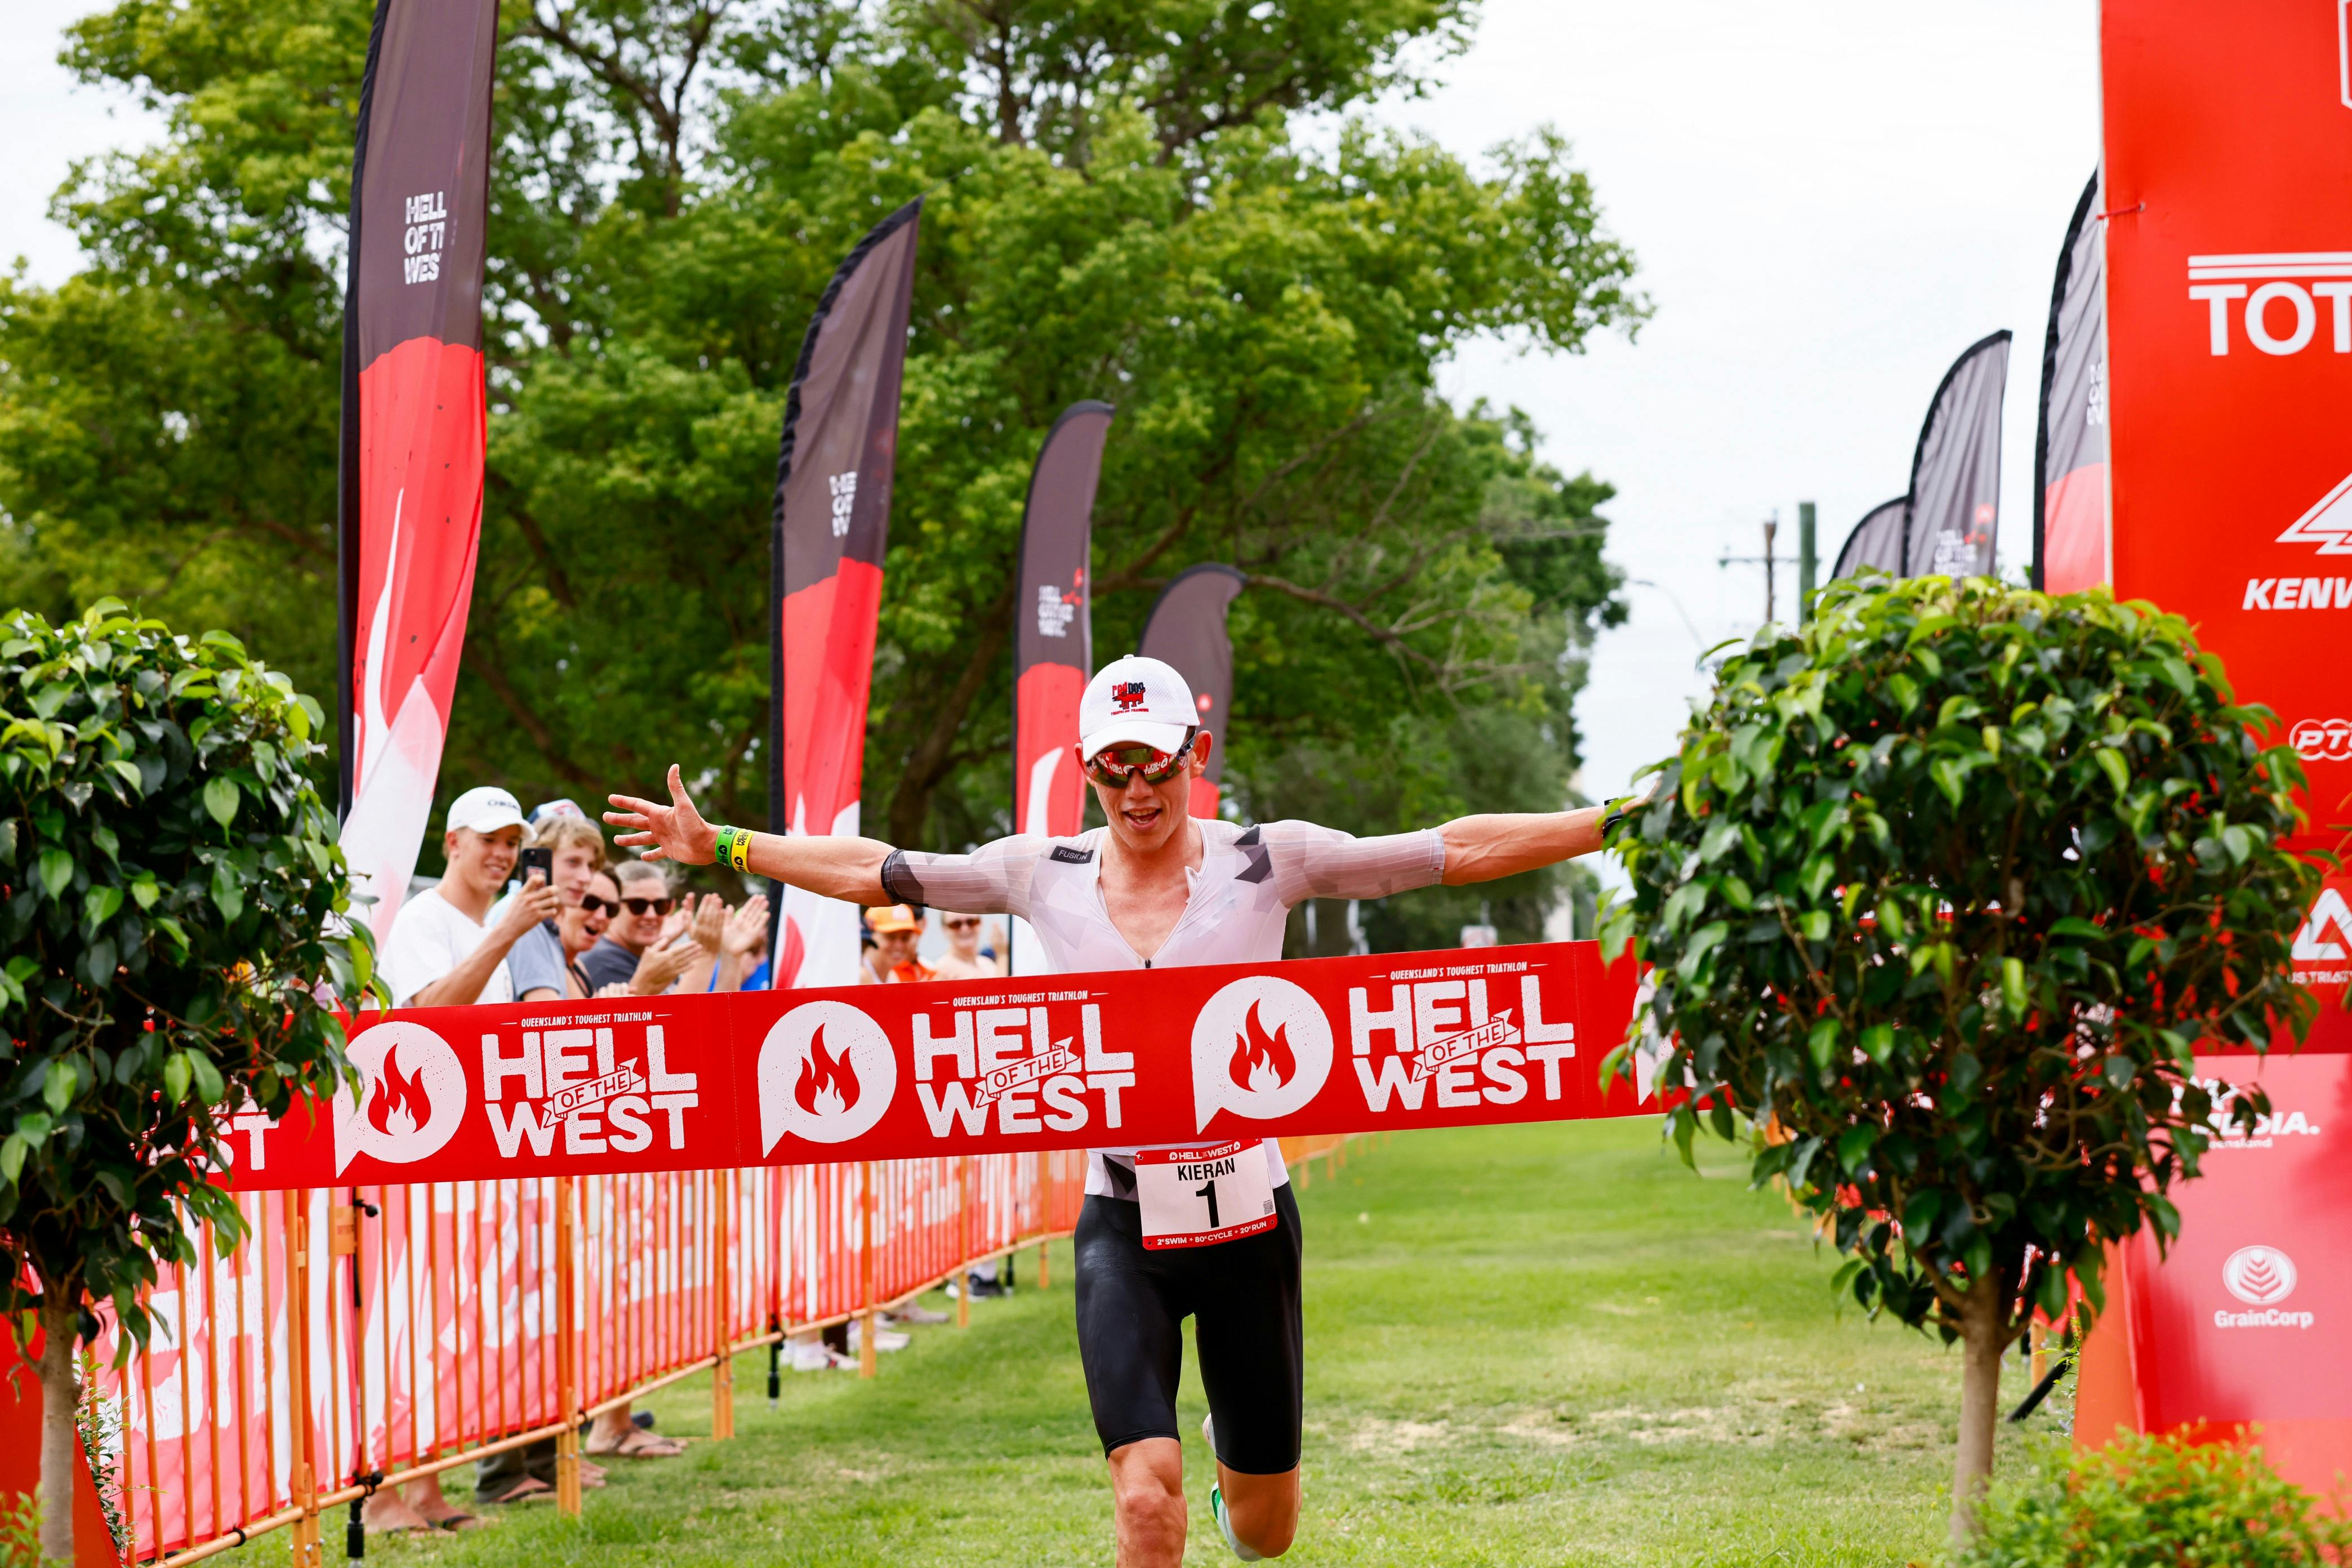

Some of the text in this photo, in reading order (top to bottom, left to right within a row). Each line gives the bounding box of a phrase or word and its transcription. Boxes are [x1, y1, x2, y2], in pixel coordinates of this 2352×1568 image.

[406, 191, 447, 224] HELL
[404, 225, 428, 255] OF
[2189, 281, 2352, 356] TOT
[2295, 729, 2352, 750] PT
[1059, 849, 1088, 860] FUSION
[1390, 961, 1527, 980] QUEENSLAND'S TOUGHEST TRIATHLON
[953, 990, 1088, 1006] QUEENSLAND'S TOUGHEST TRIATHLON
[1348, 974, 1574, 1055] HELL
[521, 1012, 652, 1027] QUEENSLAND'S TOUGHEST TRIATHLON
[912, 1003, 1134, 1081] HELL
[1433, 1024, 1502, 1061] OF THE
[481, 1024, 697, 1101] HELL
[994, 1052, 1062, 1087] OF THE
[1352, 1043, 1576, 1112] WEST
[561, 1073, 628, 1107] OF THE
[915, 1072, 1135, 1138] WEST
[485, 1093, 698, 1159] WEST
[1179, 1151, 1202, 1160] HELL
[1208, 1145, 1233, 1158] WEST
[2208, 1137, 2273, 1150] eensland
[1177, 1157, 1236, 1181] KIERAN
[1195, 1180, 1220, 1228] 1
[2214, 1308, 2314, 1330] GrainCorp
